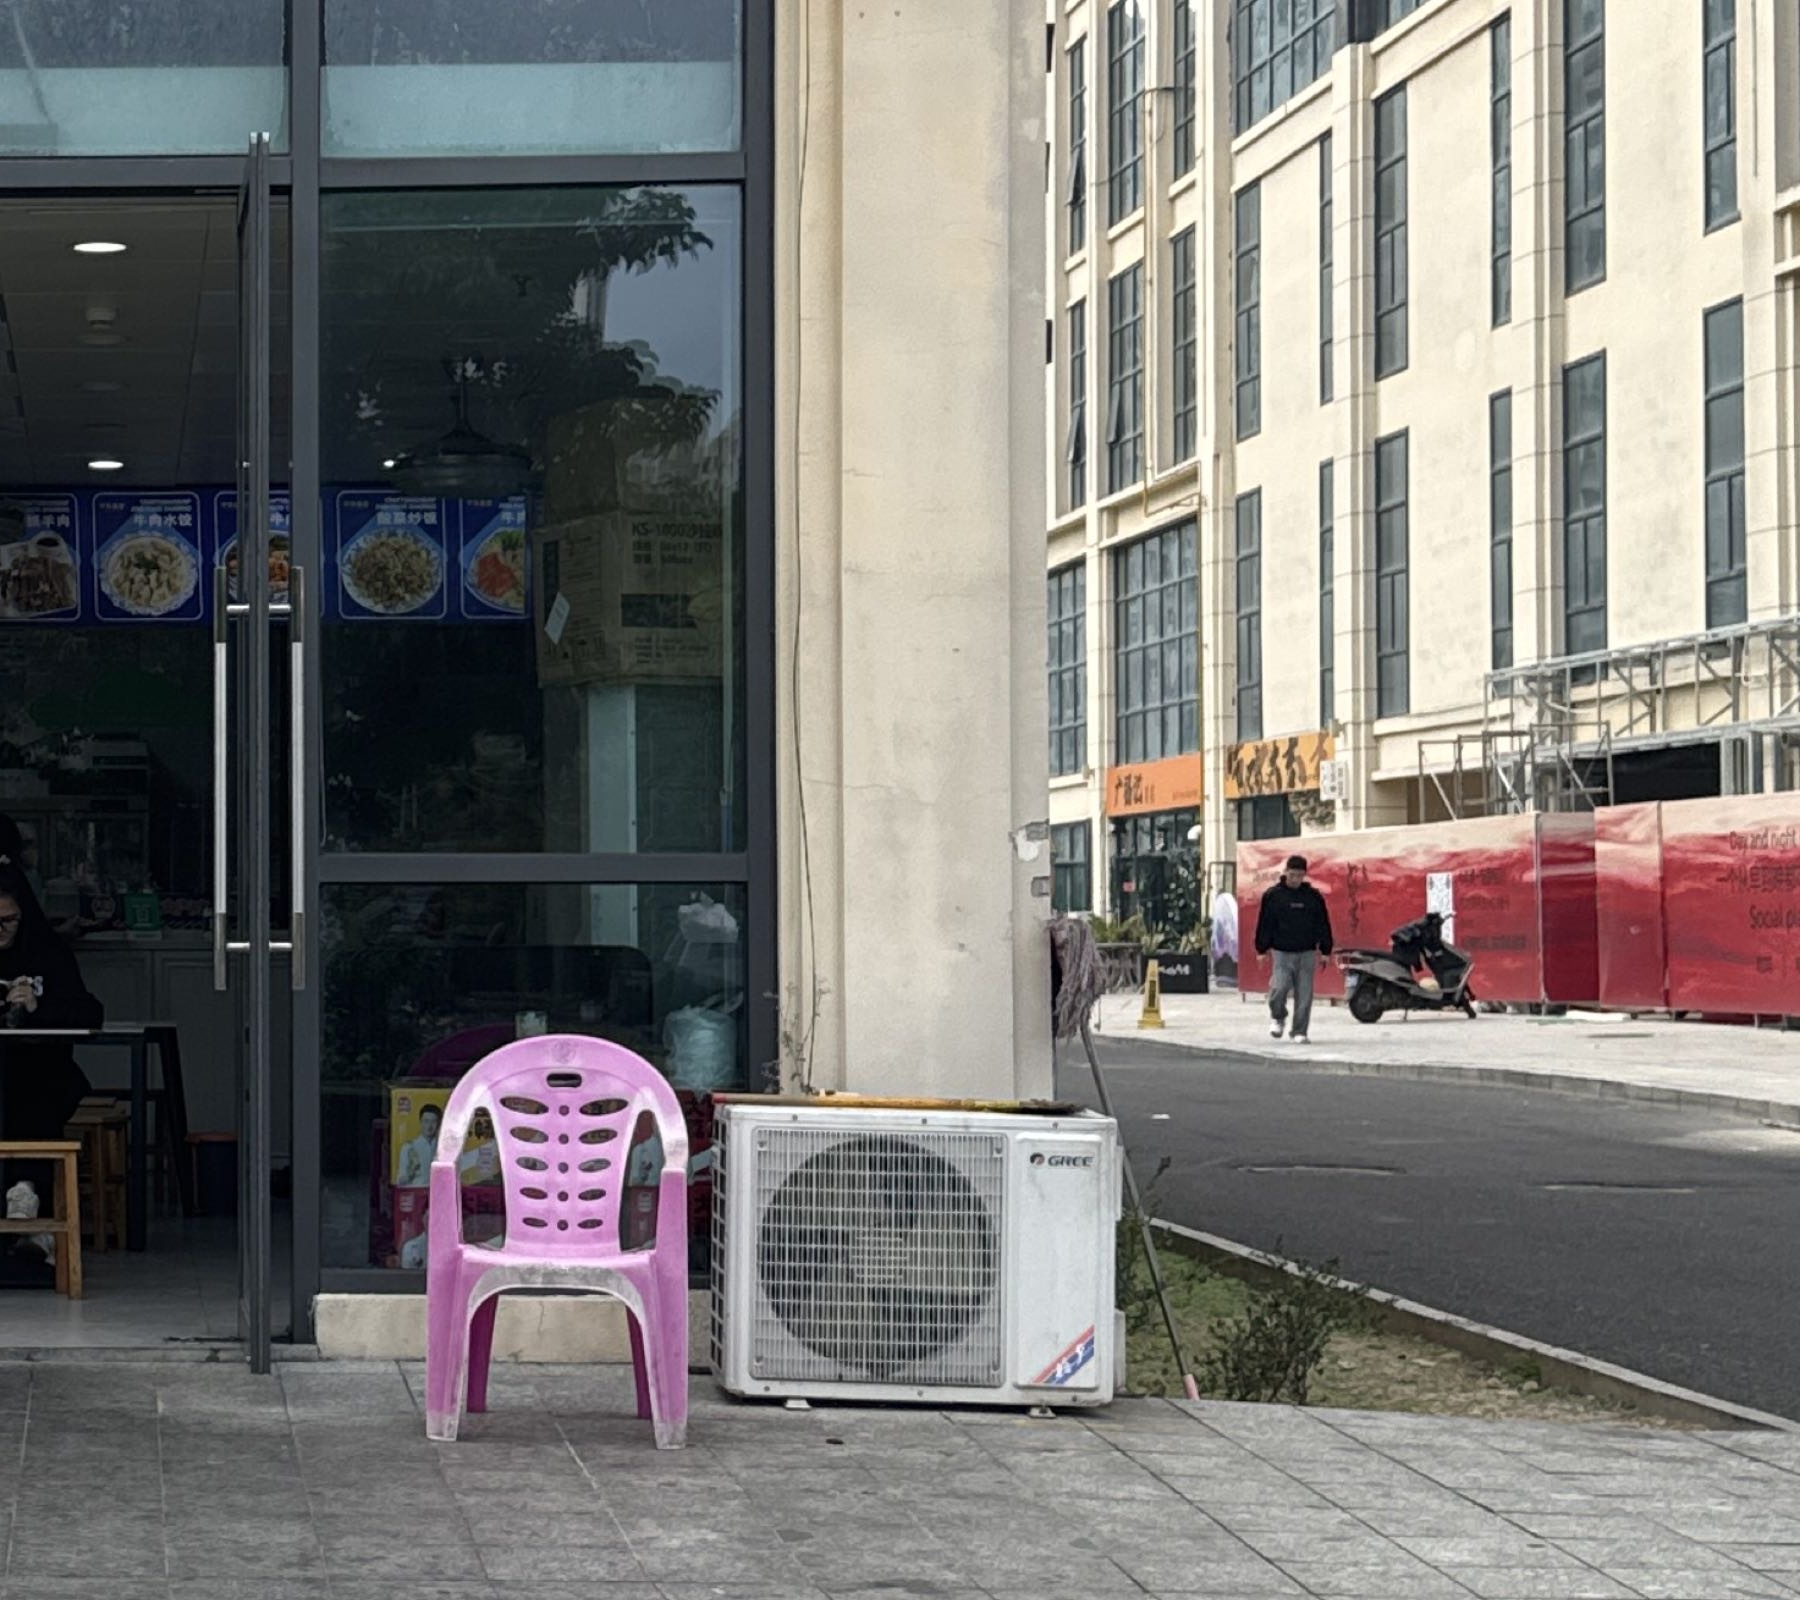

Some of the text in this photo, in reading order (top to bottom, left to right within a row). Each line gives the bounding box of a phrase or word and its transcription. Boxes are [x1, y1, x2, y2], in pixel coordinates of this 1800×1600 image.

[132, 513, 194, 528] 牛肉水饺
[1047, 1154, 1096, 1168] GREE
